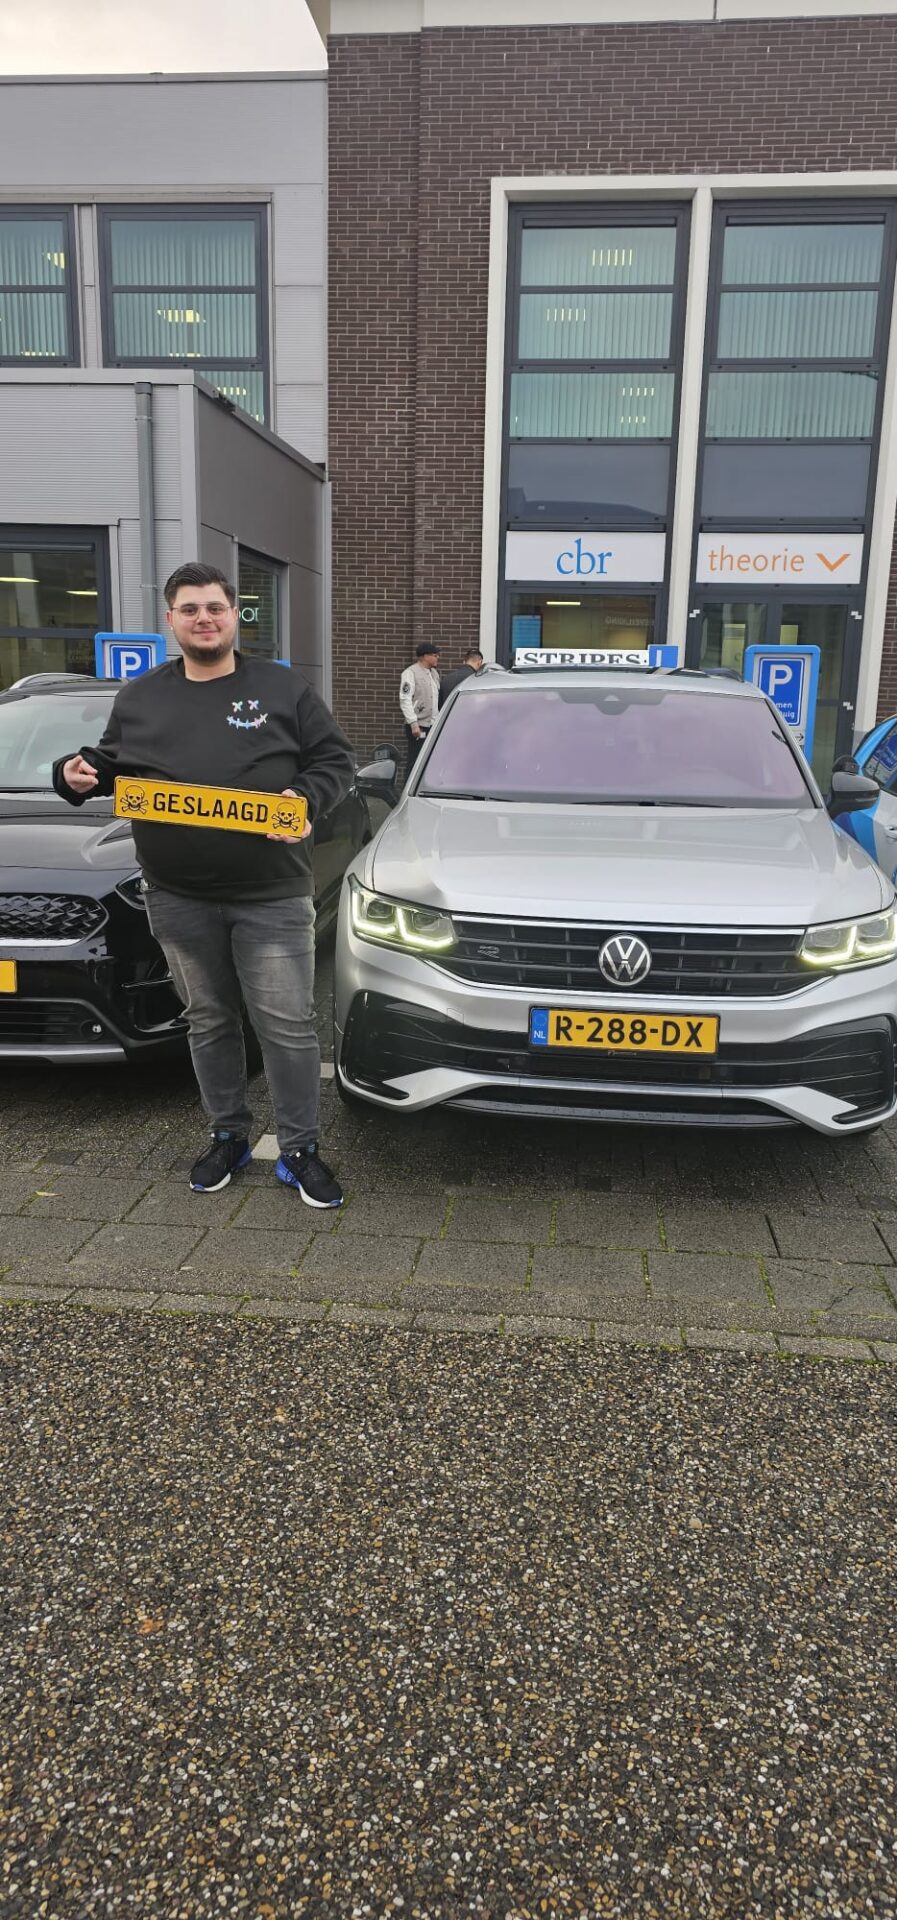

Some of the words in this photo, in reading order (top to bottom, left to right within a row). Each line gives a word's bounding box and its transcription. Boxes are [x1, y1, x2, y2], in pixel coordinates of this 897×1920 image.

[556, 538, 612, 574] cbr
[708, 545, 805, 573] theorie
[120, 651, 142, 678] P
[768, 664, 793, 696] P
[153, 792, 269, 823] GESLAAGD
[533, 1030, 546, 1039] NL
[555, 1015, 704, 1048] R-288-DX
